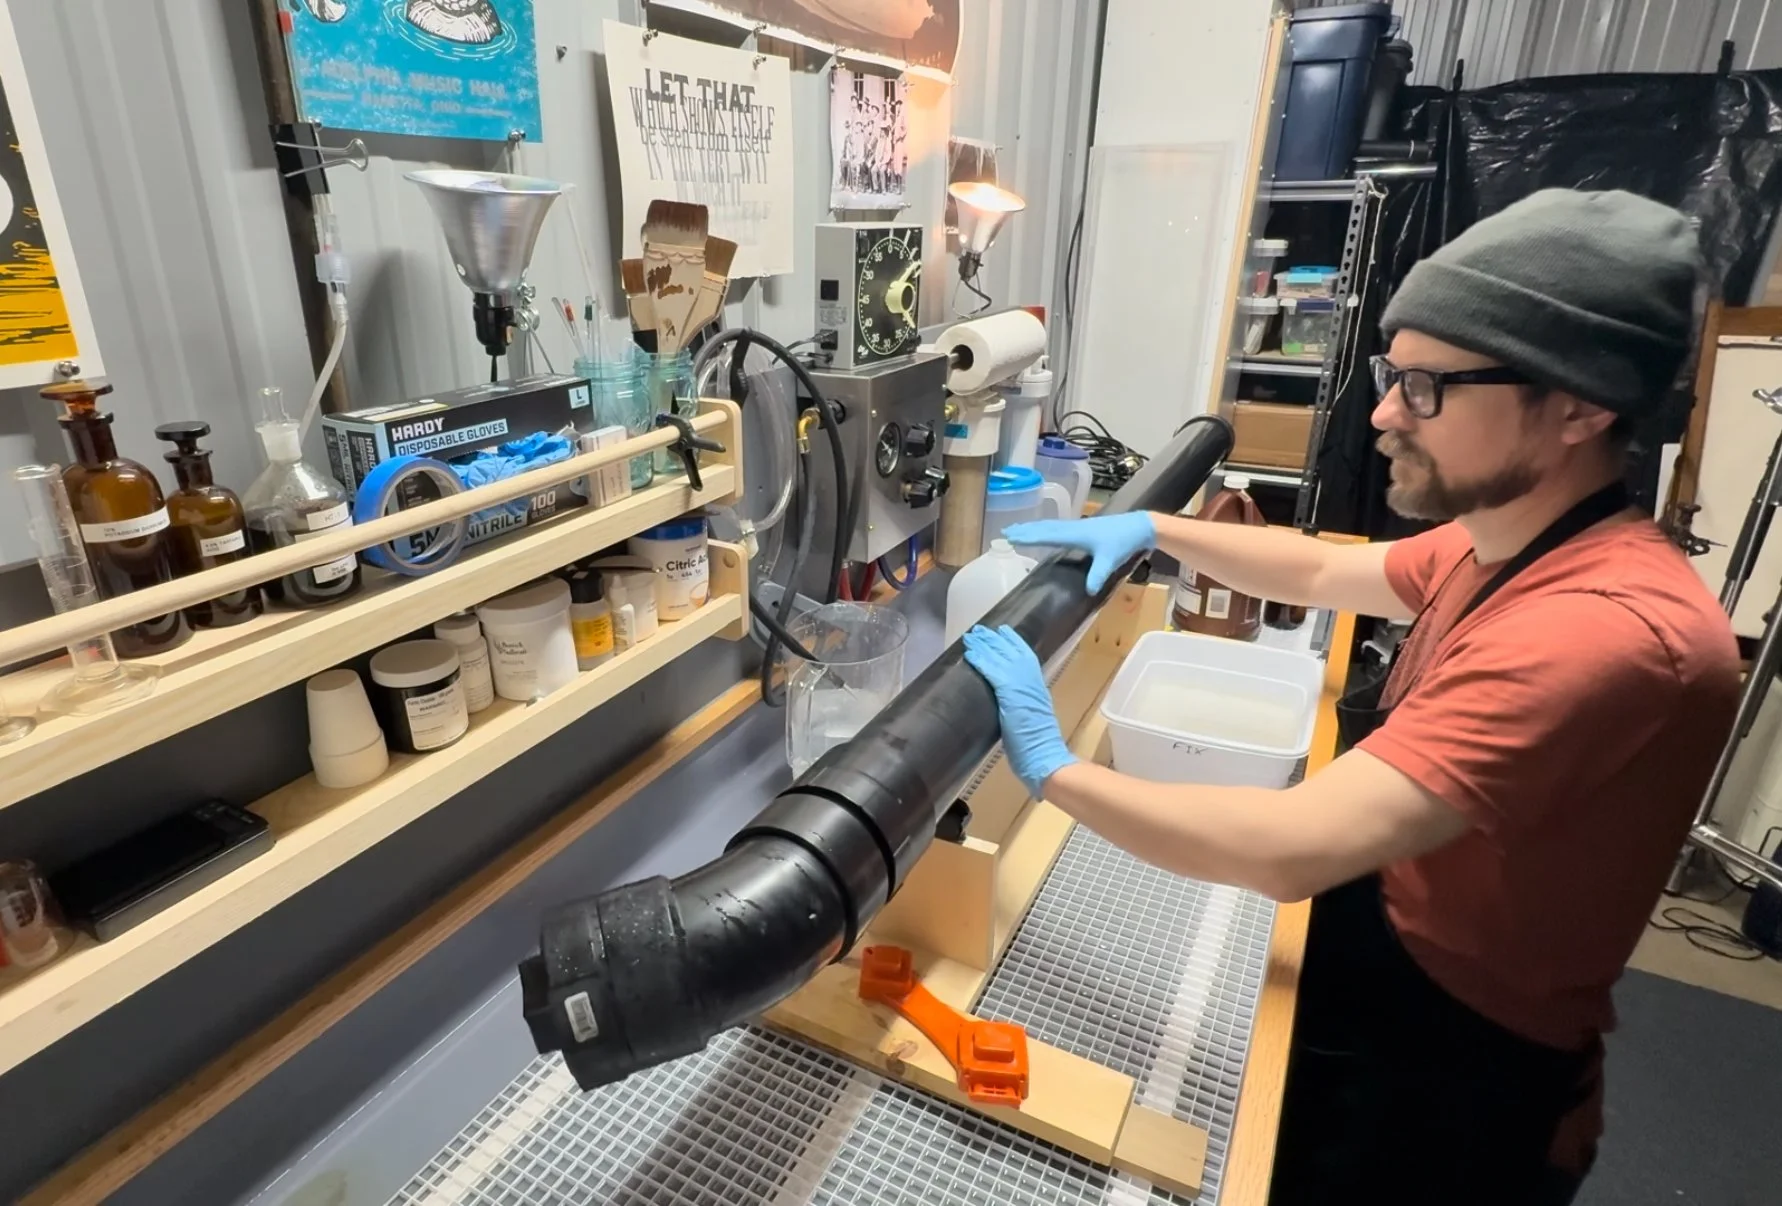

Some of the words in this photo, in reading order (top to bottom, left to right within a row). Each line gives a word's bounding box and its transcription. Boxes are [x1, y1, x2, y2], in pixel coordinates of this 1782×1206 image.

[645, 68, 689, 105] LET
[696, 77, 756, 114] THAT
[629, 86, 679, 132] WHICH
[682, 96, 726, 136] SHOWS
[731, 104, 775, 140] ITSELF
[661, 128, 692, 149] seen
[576, 390, 582, 400] L
[391, 417, 446, 442] HARDY
[398, 432, 466, 456] DISPOSABLE
[467, 422, 506, 442] GLOVES
[365, 437, 377, 469] HARD
[530, 490, 556, 510] 100
[409, 527, 440, 558] 5M
[464, 513, 523, 541] NITRILE
[665, 558, 697, 571] Citric
[697, 554, 708, 565] Ac
[1172, 740, 1209, 756] FIX
